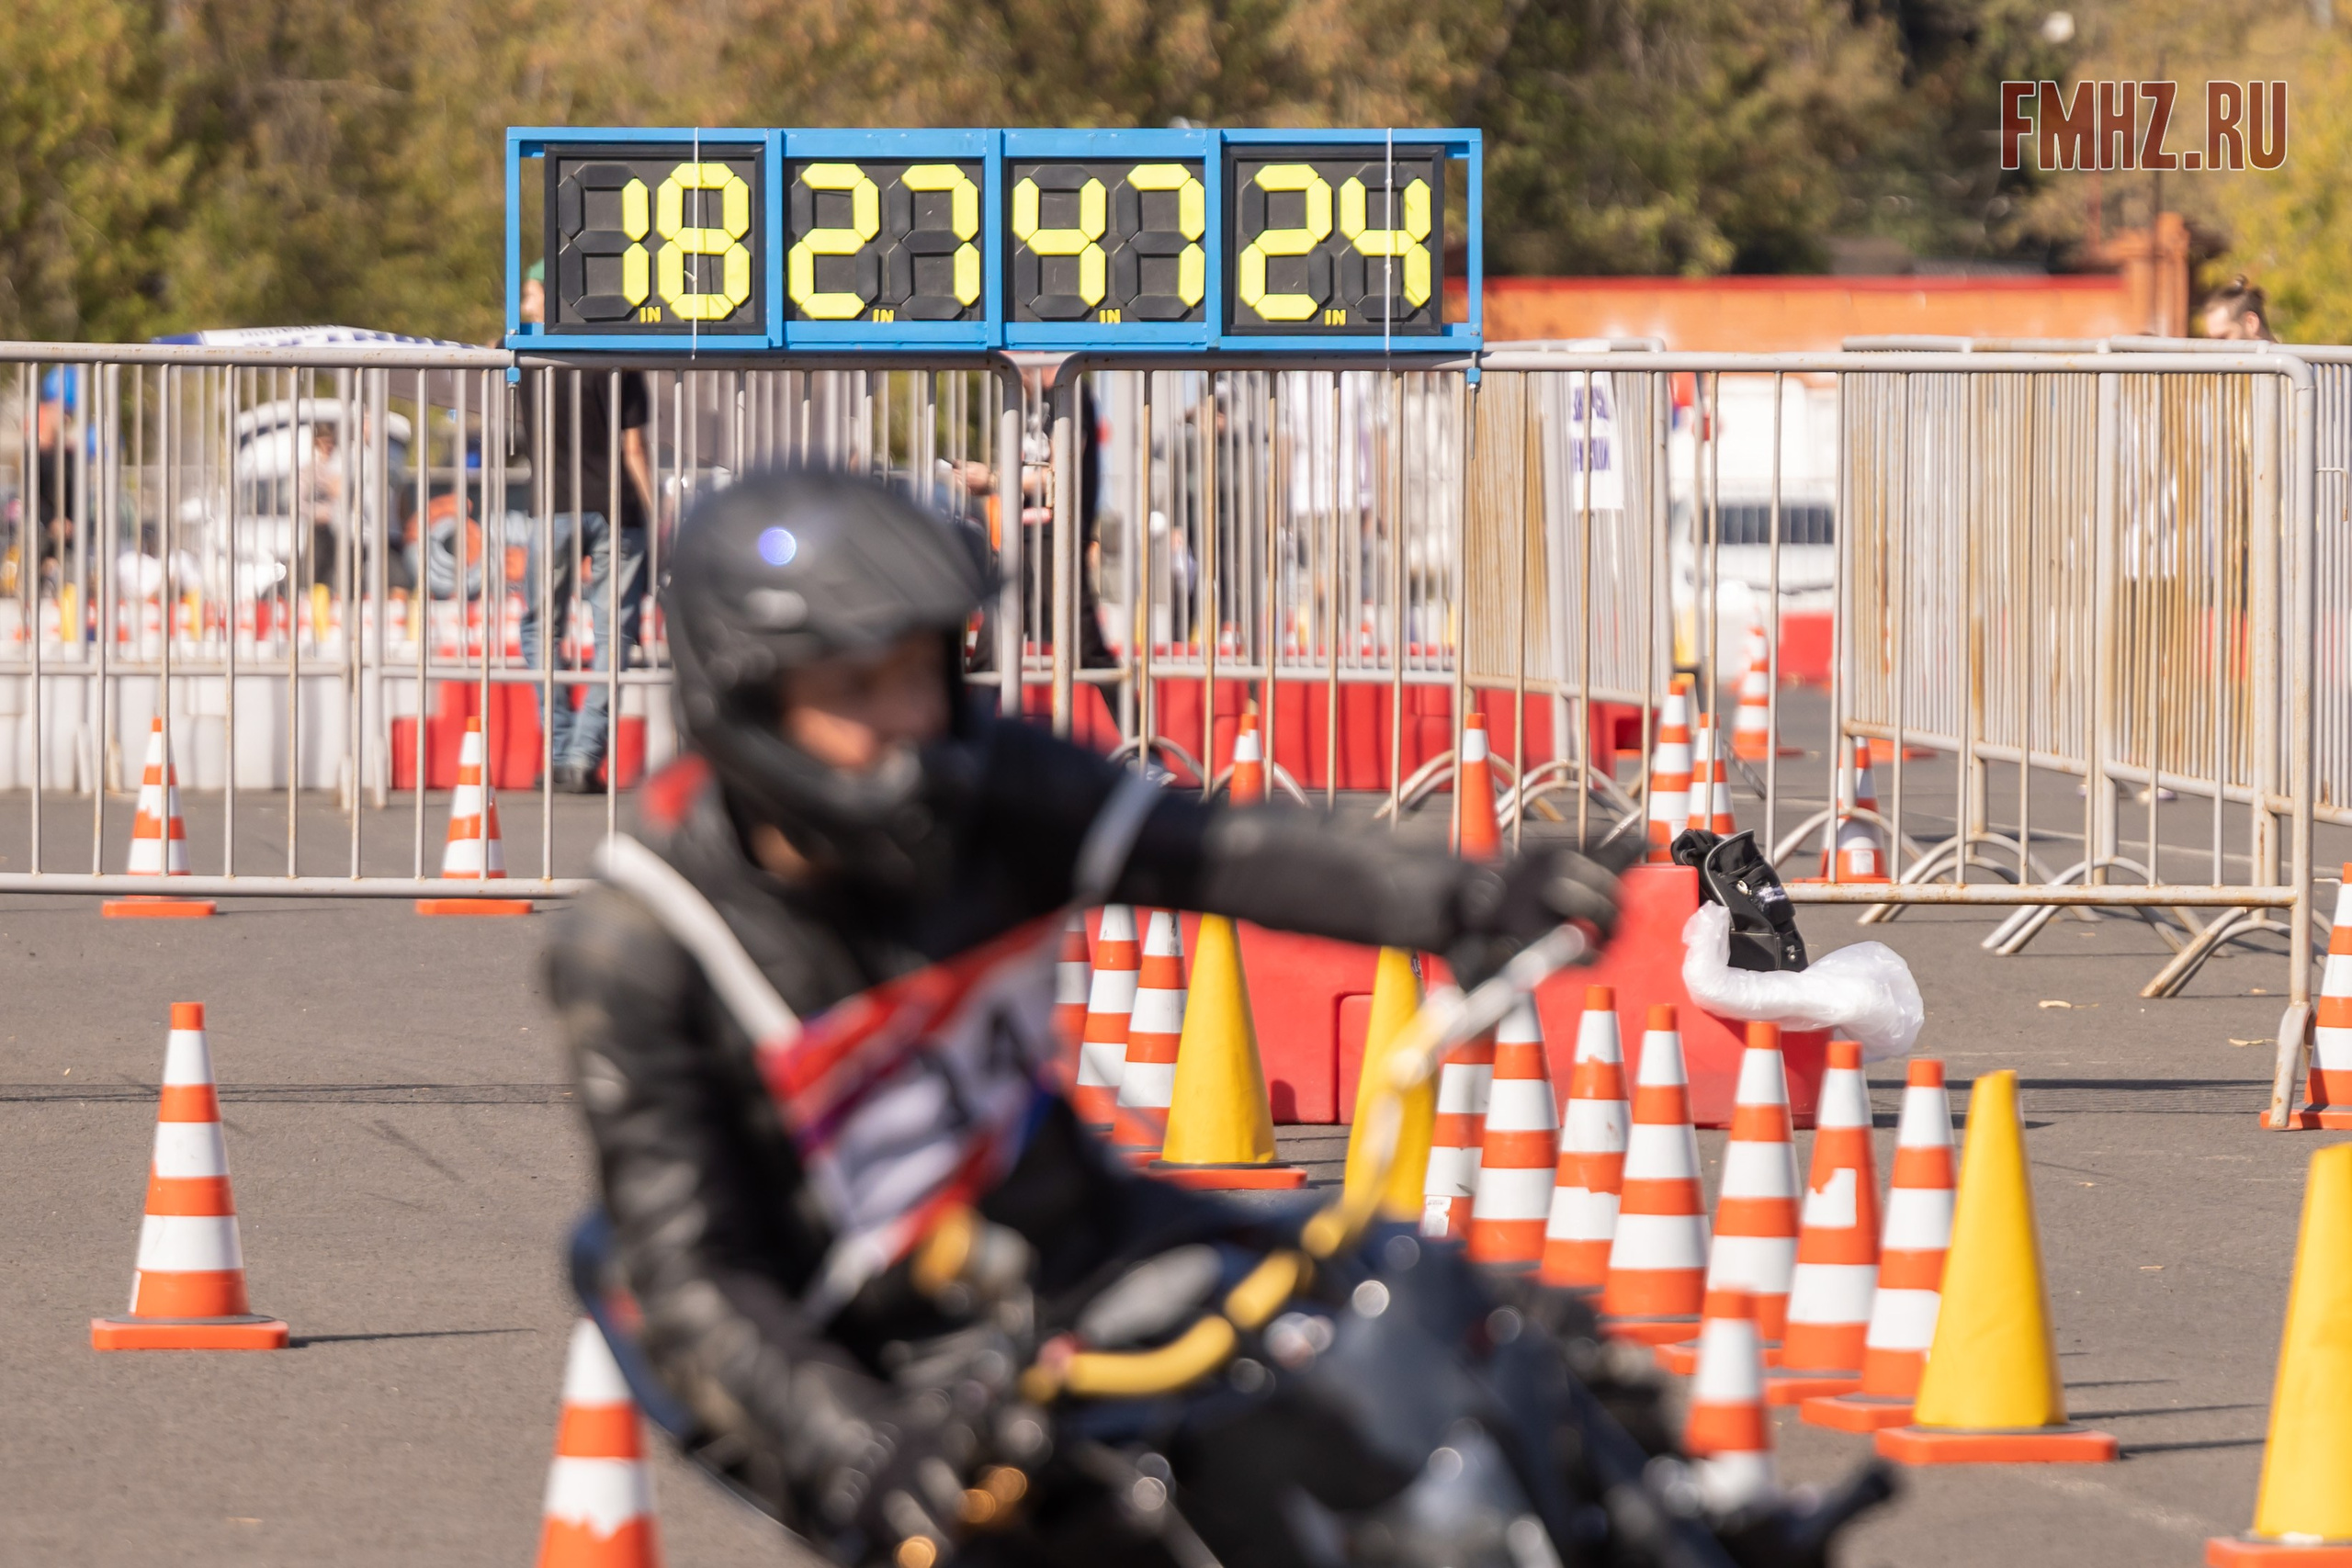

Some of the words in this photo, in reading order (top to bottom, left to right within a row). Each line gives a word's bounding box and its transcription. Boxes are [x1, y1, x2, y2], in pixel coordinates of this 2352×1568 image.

[622, 163, 751, 321] 18
[787, 164, 980, 320] 27
[1012, 164, 1205, 308] 47
[1238, 164, 1431, 321] 24
[639, 306, 662, 323] IN
[872, 309, 895, 322] IN
[1099, 309, 1121, 323] IN
[1324, 309, 1347, 326] IN
